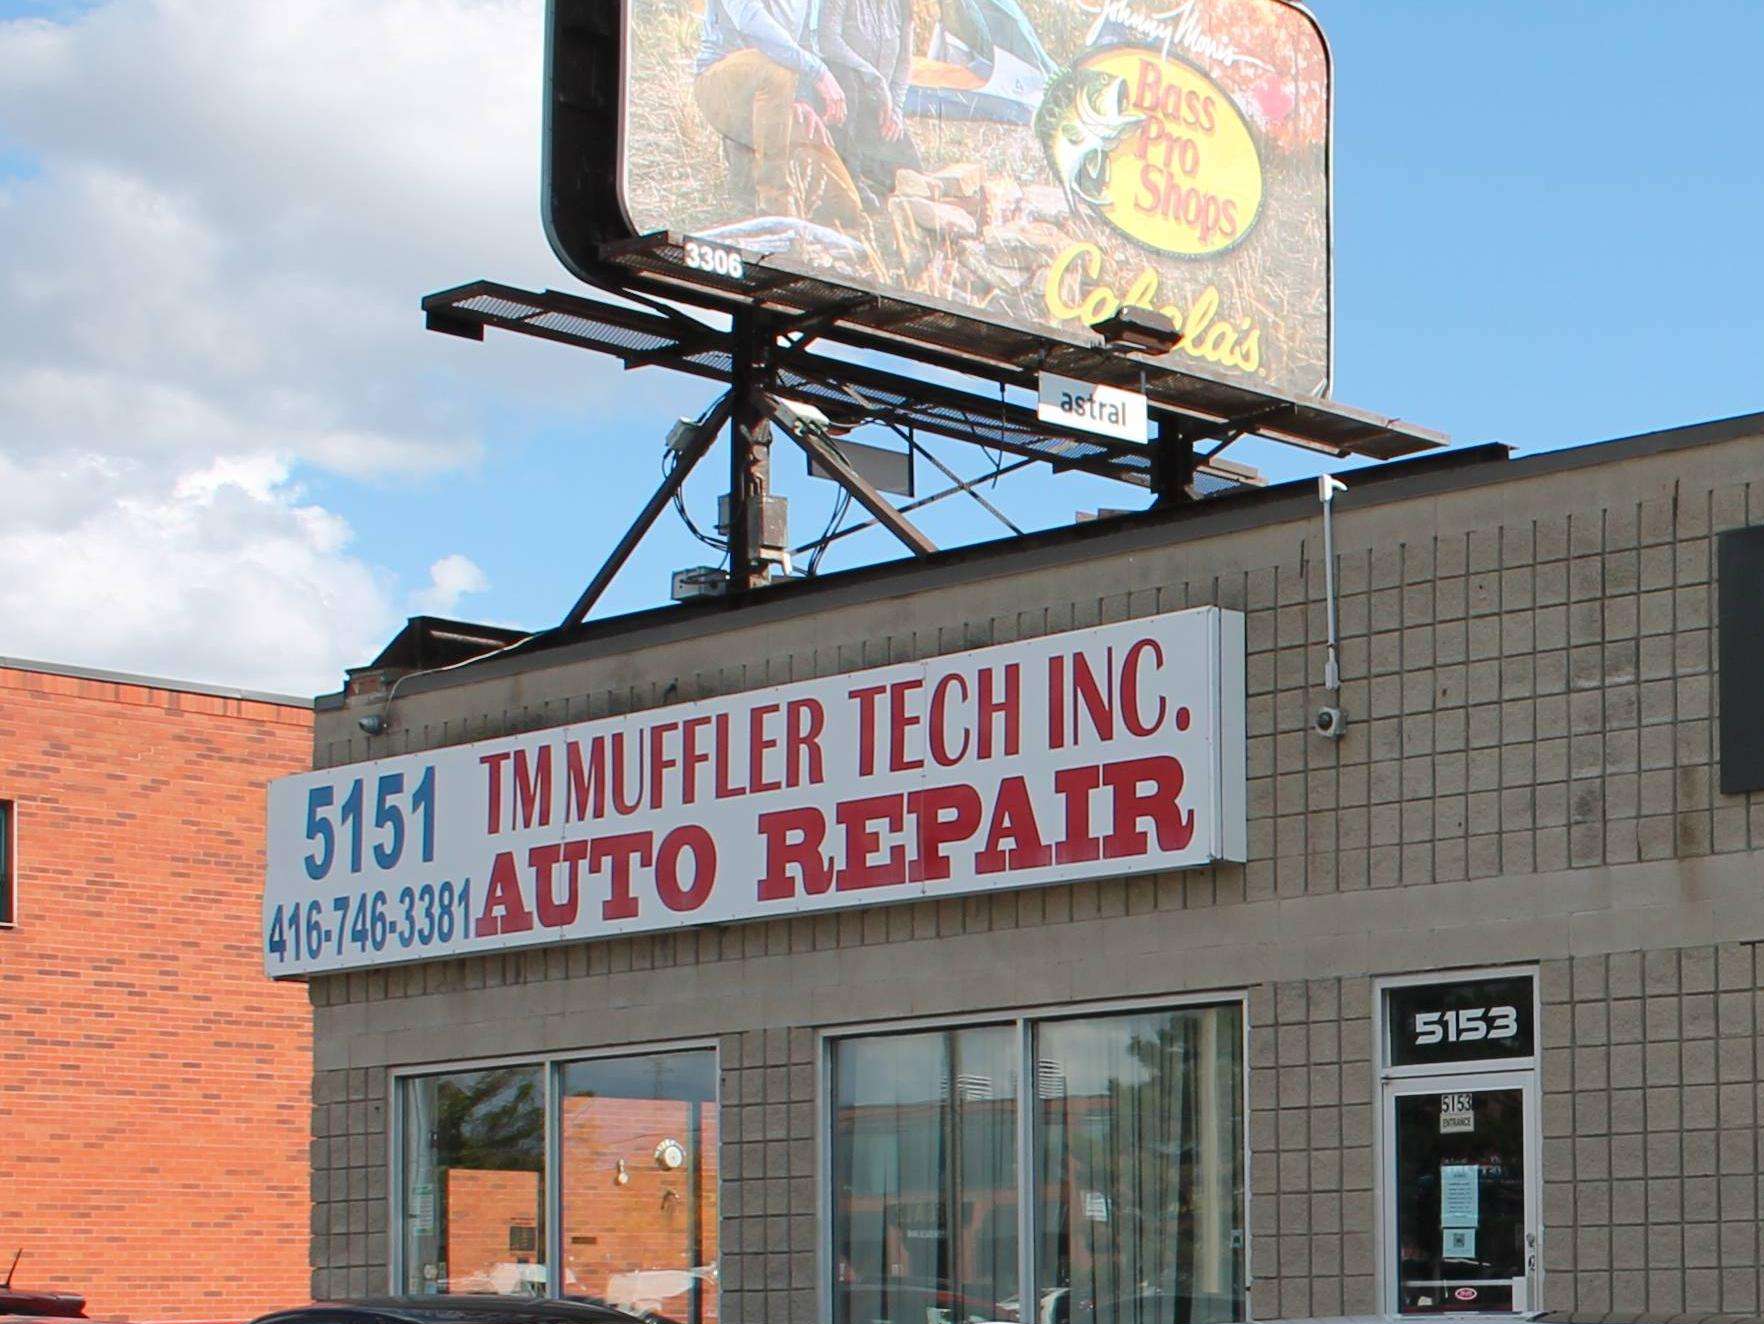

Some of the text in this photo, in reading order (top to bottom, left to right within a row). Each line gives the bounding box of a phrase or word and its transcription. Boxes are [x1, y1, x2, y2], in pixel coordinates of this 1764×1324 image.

[1133, 58, 1216, 133] Bass
[1135, 114, 1200, 178] Pro
[1134, 163, 1238, 244] Shops
[684, 242, 743, 279] 3306
[1060, 391, 1127, 426] astral
[479, 638, 1190, 835] TM MUFFLER TECH INC.
[304, 766, 435, 880] 5151
[475, 755, 1195, 938] AUTO REPAIR
[269, 877, 471, 963] 416-746-3381
[1415, 1005, 1517, 1045] 5153
[1442, 1093, 1472, 1113] 5153
